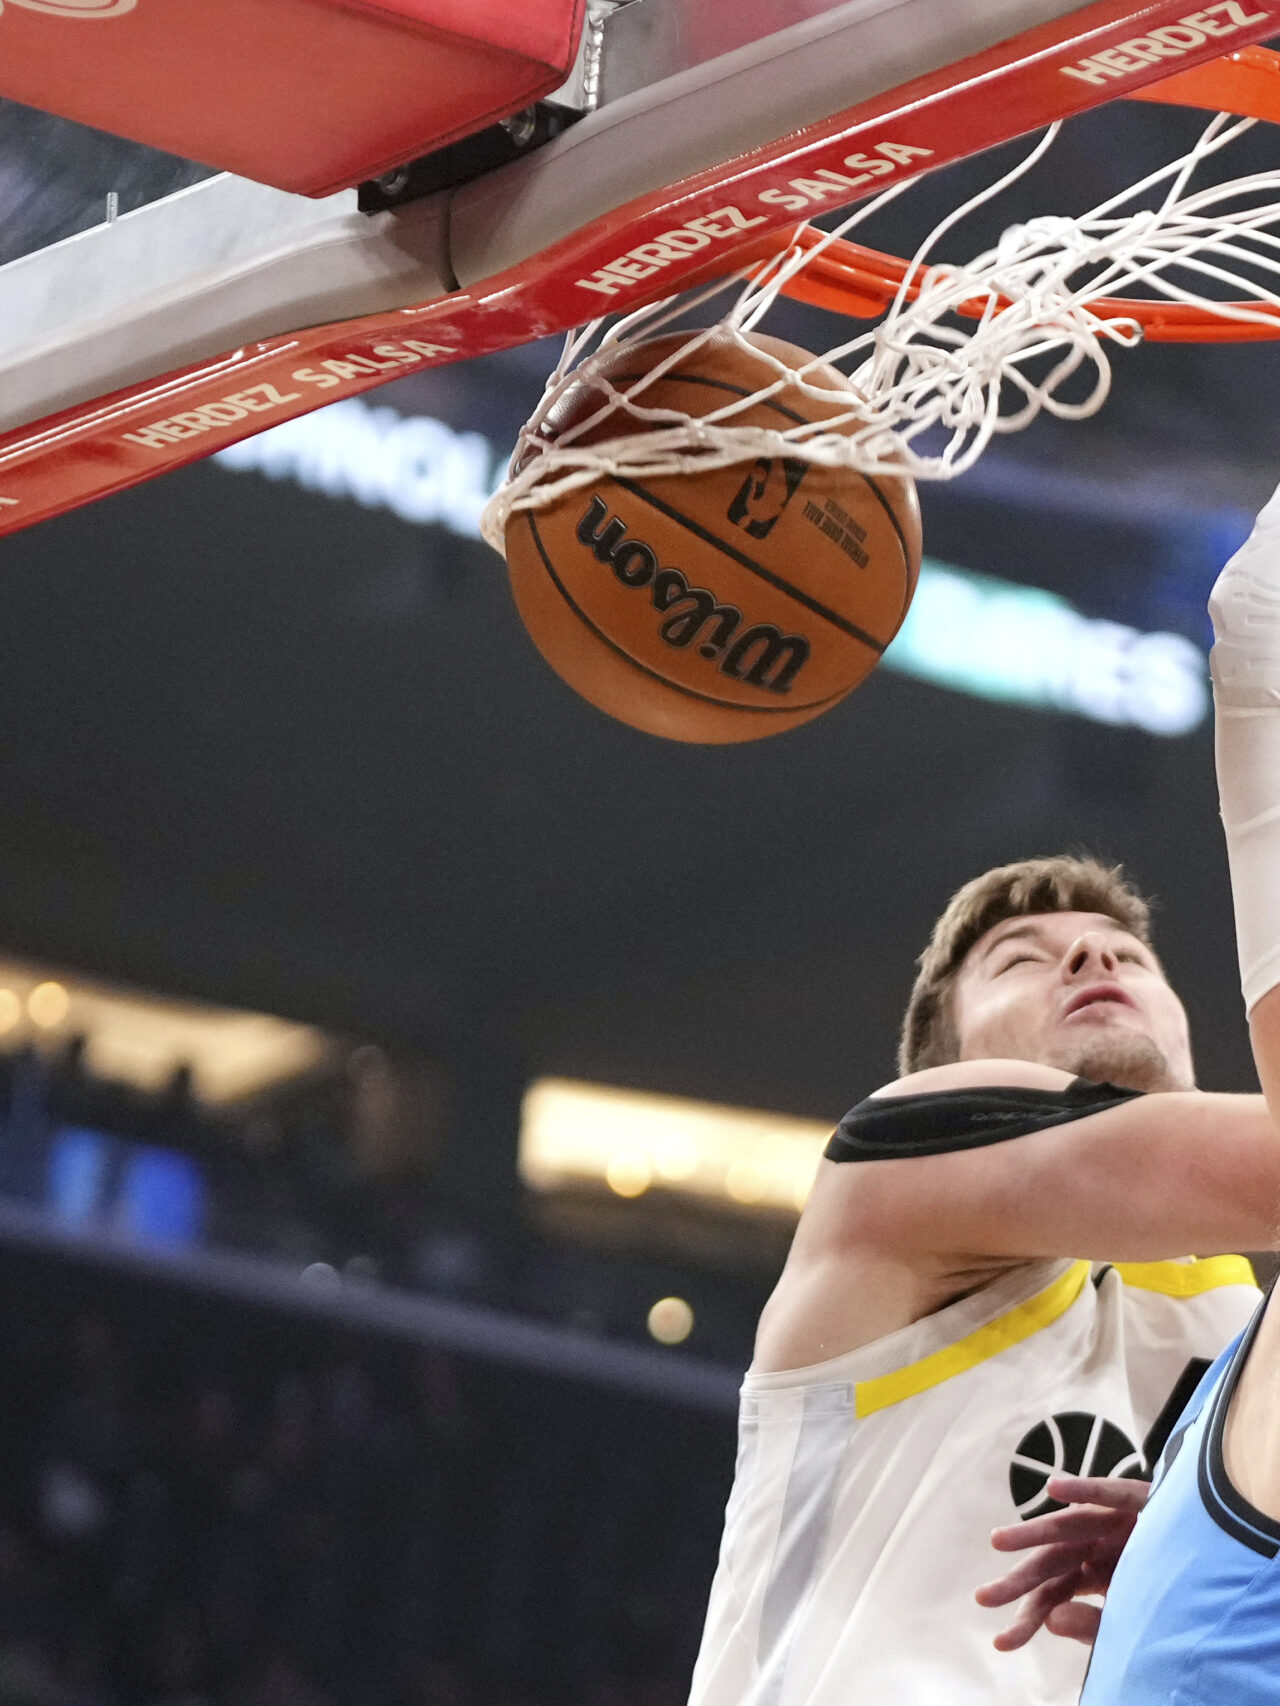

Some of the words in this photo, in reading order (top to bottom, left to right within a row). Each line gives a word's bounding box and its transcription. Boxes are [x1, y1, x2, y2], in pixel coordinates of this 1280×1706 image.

[1059, 0, 1270, 86] HERDEZ
[574, 205, 729, 295] HERDEZ
[758, 141, 935, 211] SALSA
[122, 382, 302, 449] HERDEZ
[292, 339, 459, 388] SALSA
[575, 492, 812, 695] Wilson
